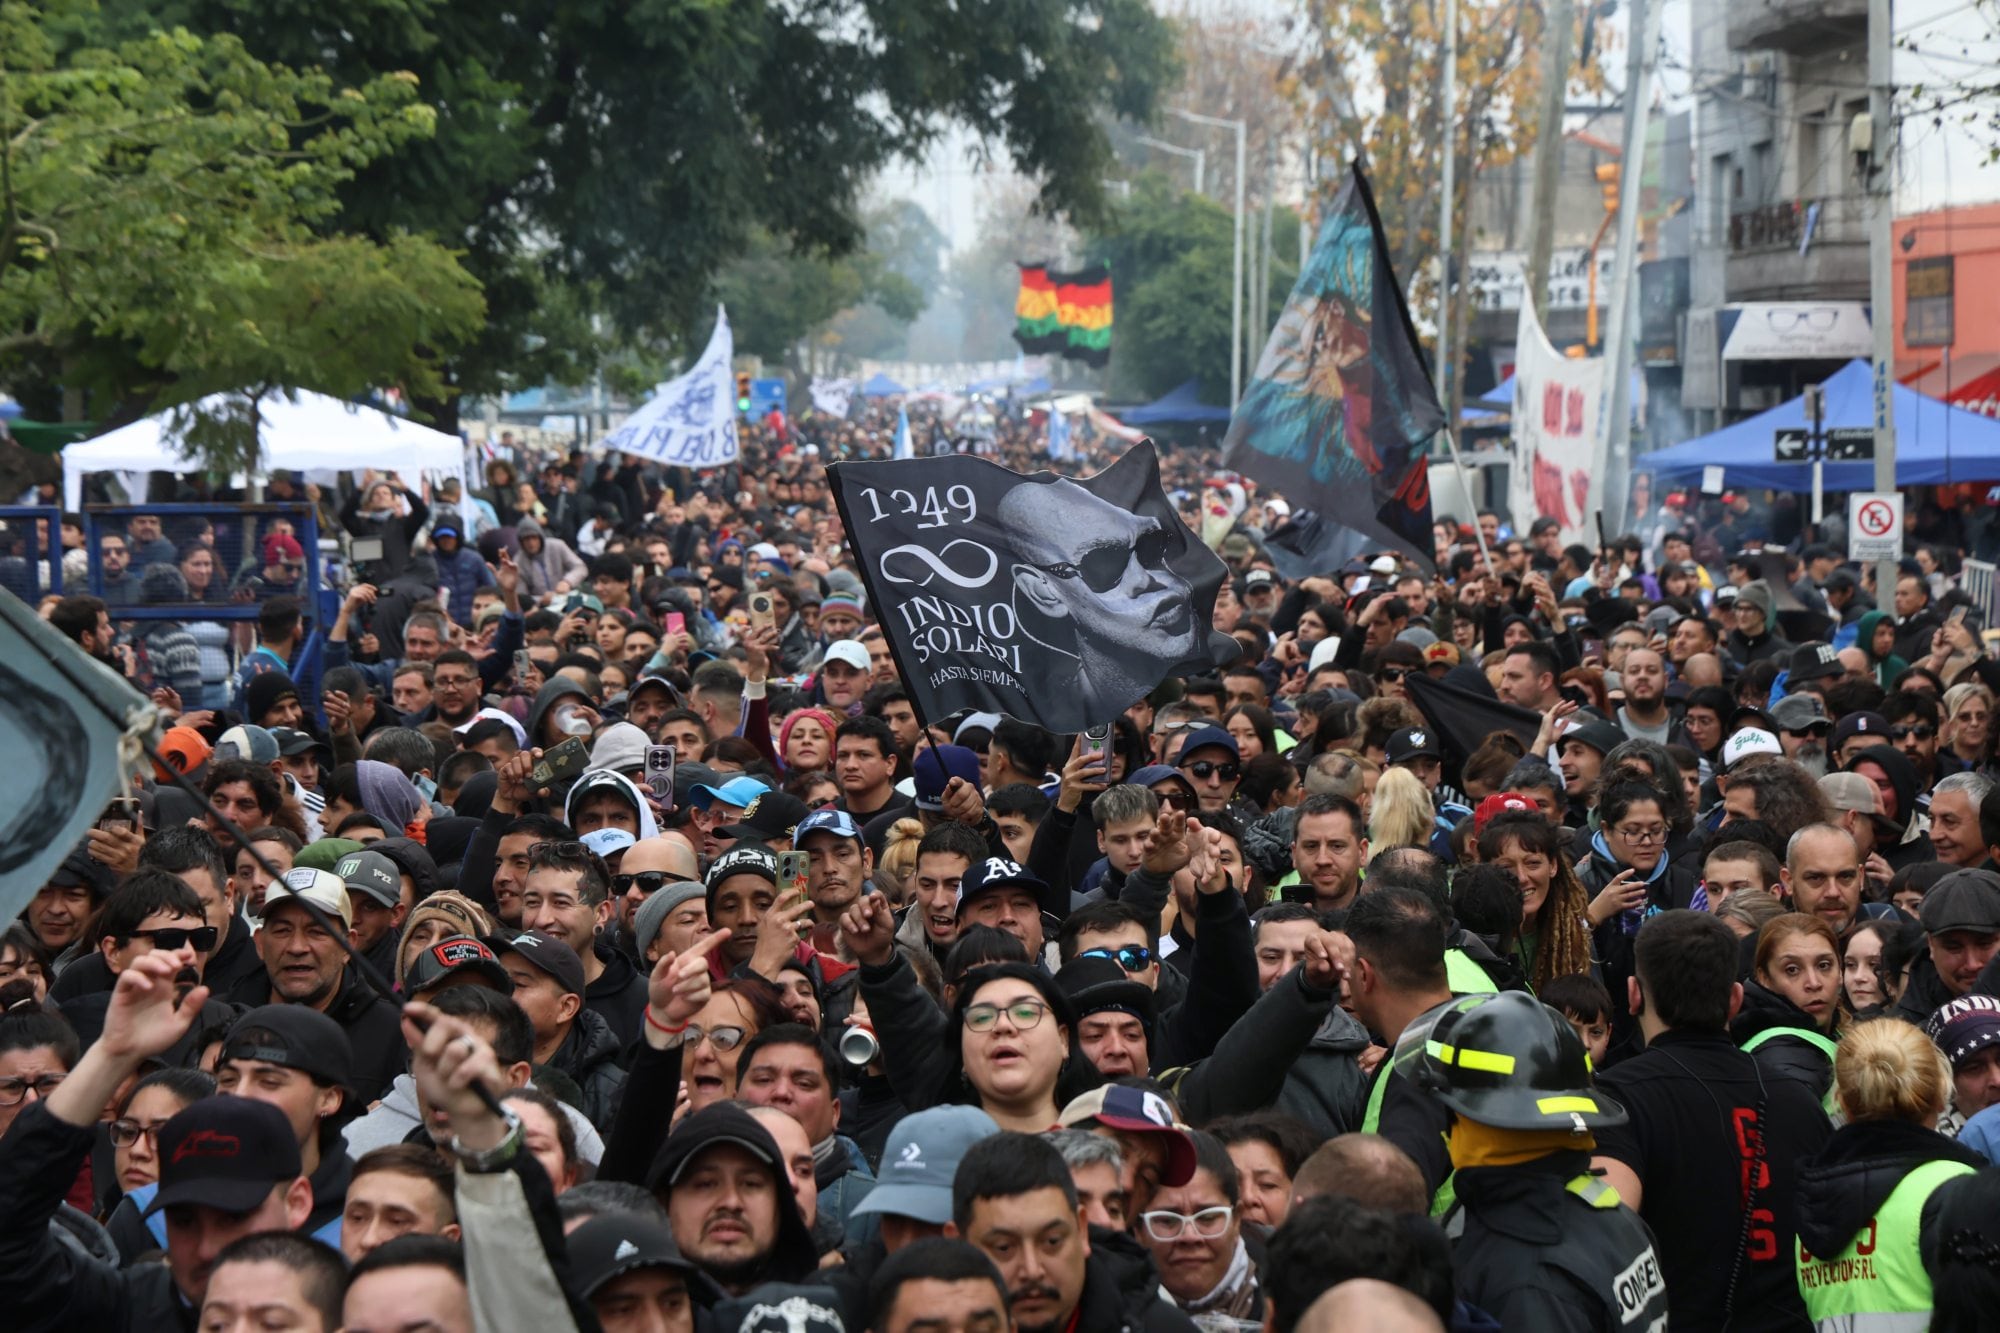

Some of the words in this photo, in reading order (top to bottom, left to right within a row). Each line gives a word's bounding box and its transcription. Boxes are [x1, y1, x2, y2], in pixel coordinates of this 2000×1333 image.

[897, 595, 1015, 639] INDIO
[912, 626, 1023, 674] SOLARI
[929, 666, 970, 689] HASTA
[982, 856, 1022, 884] A's
